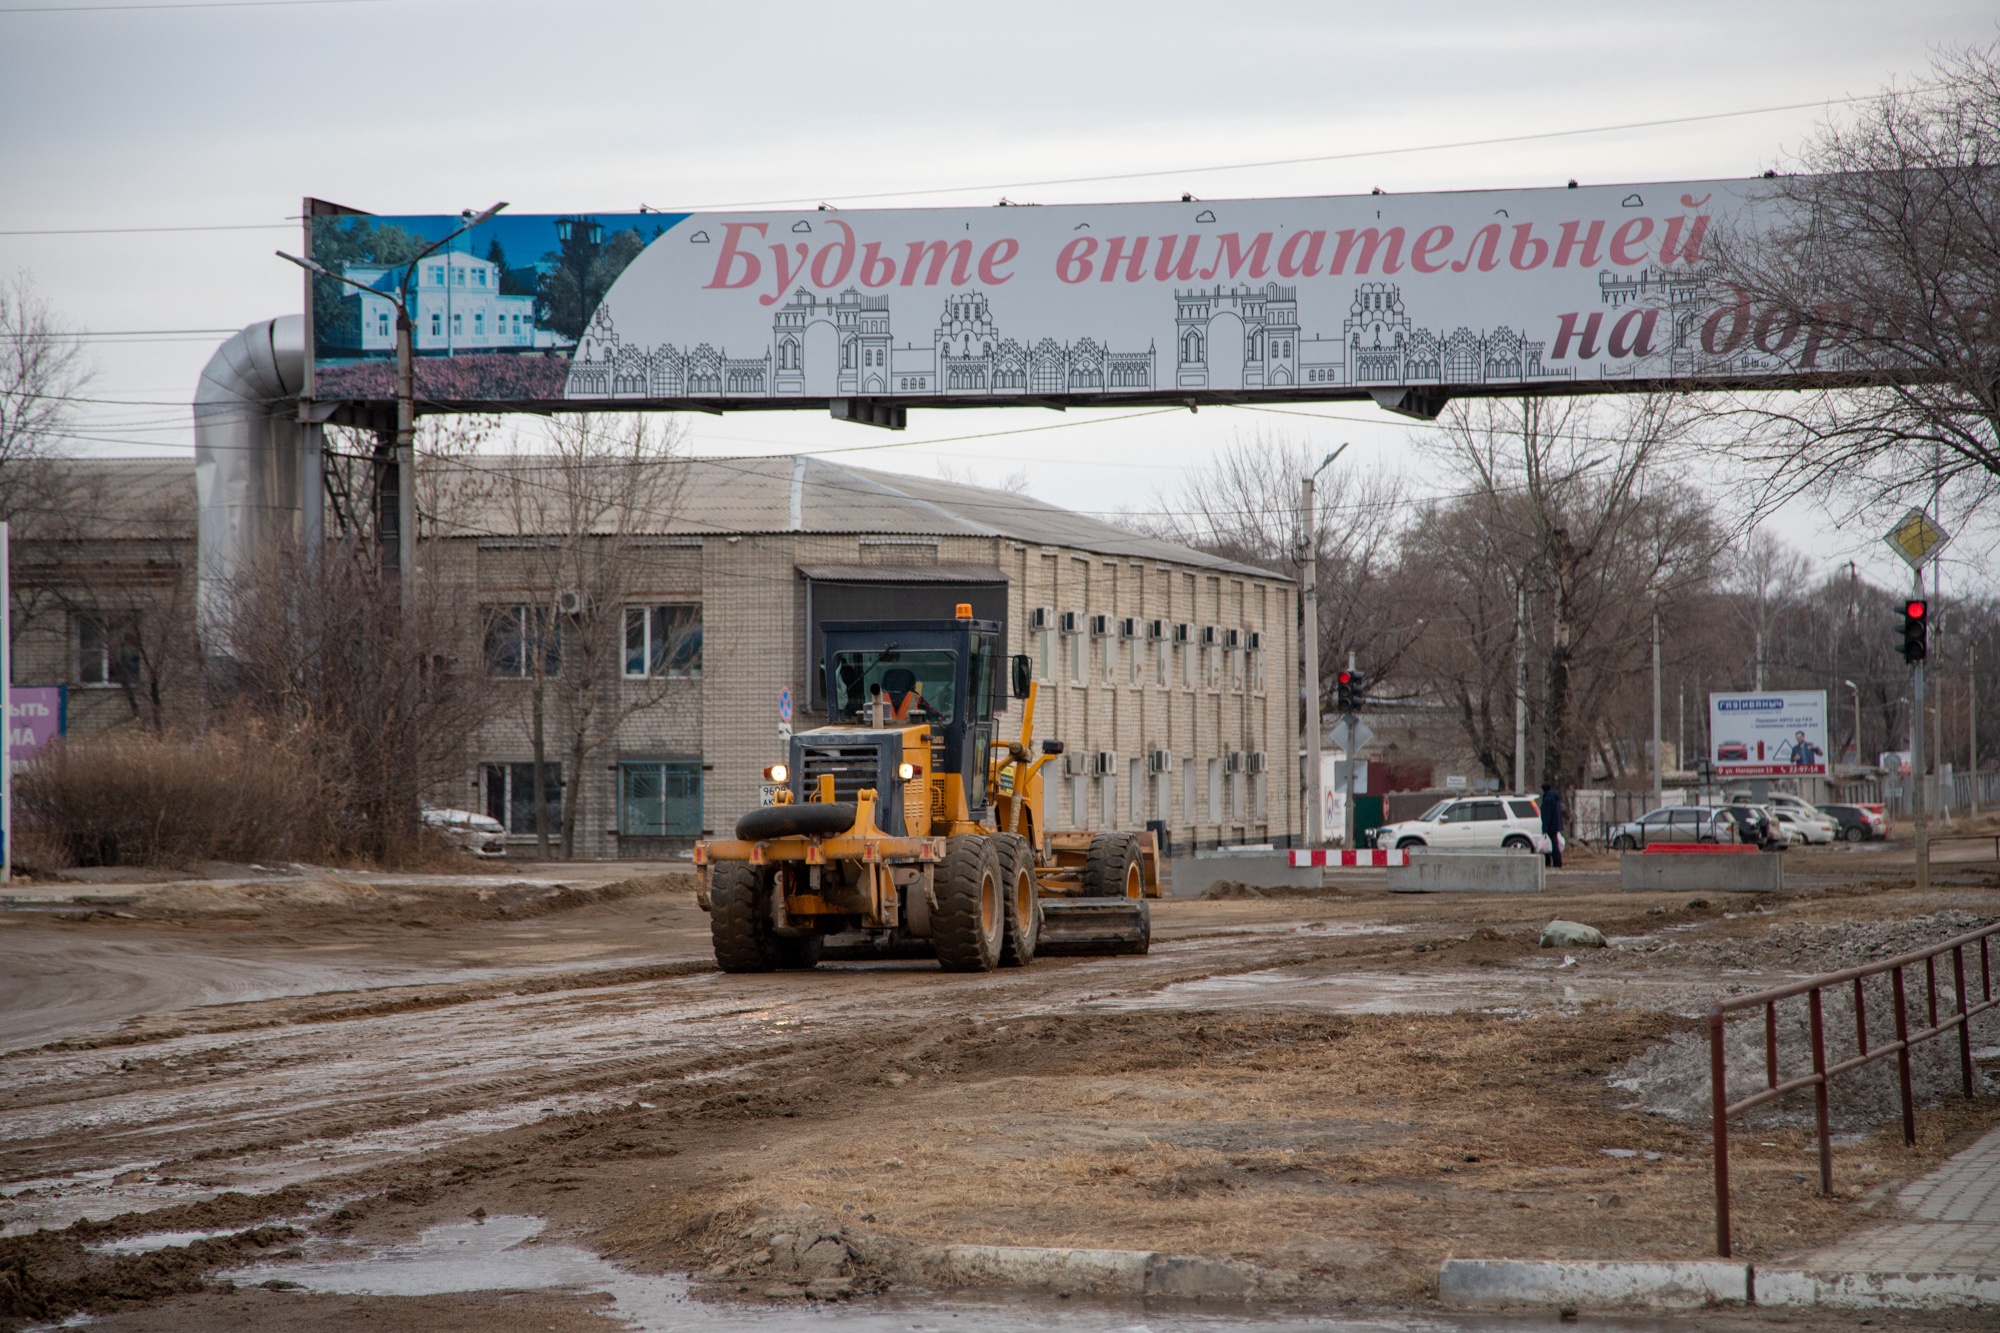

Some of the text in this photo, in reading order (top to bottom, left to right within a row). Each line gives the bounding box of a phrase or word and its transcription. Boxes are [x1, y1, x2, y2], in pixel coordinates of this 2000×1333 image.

[701, 193, 1714, 307] Будьте внимательней
[1551, 308, 1661, 360] на
[1719, 700, 1739, 710] ГАЗ
[1741, 699, 1783, 710] ИВАНЫЧ
